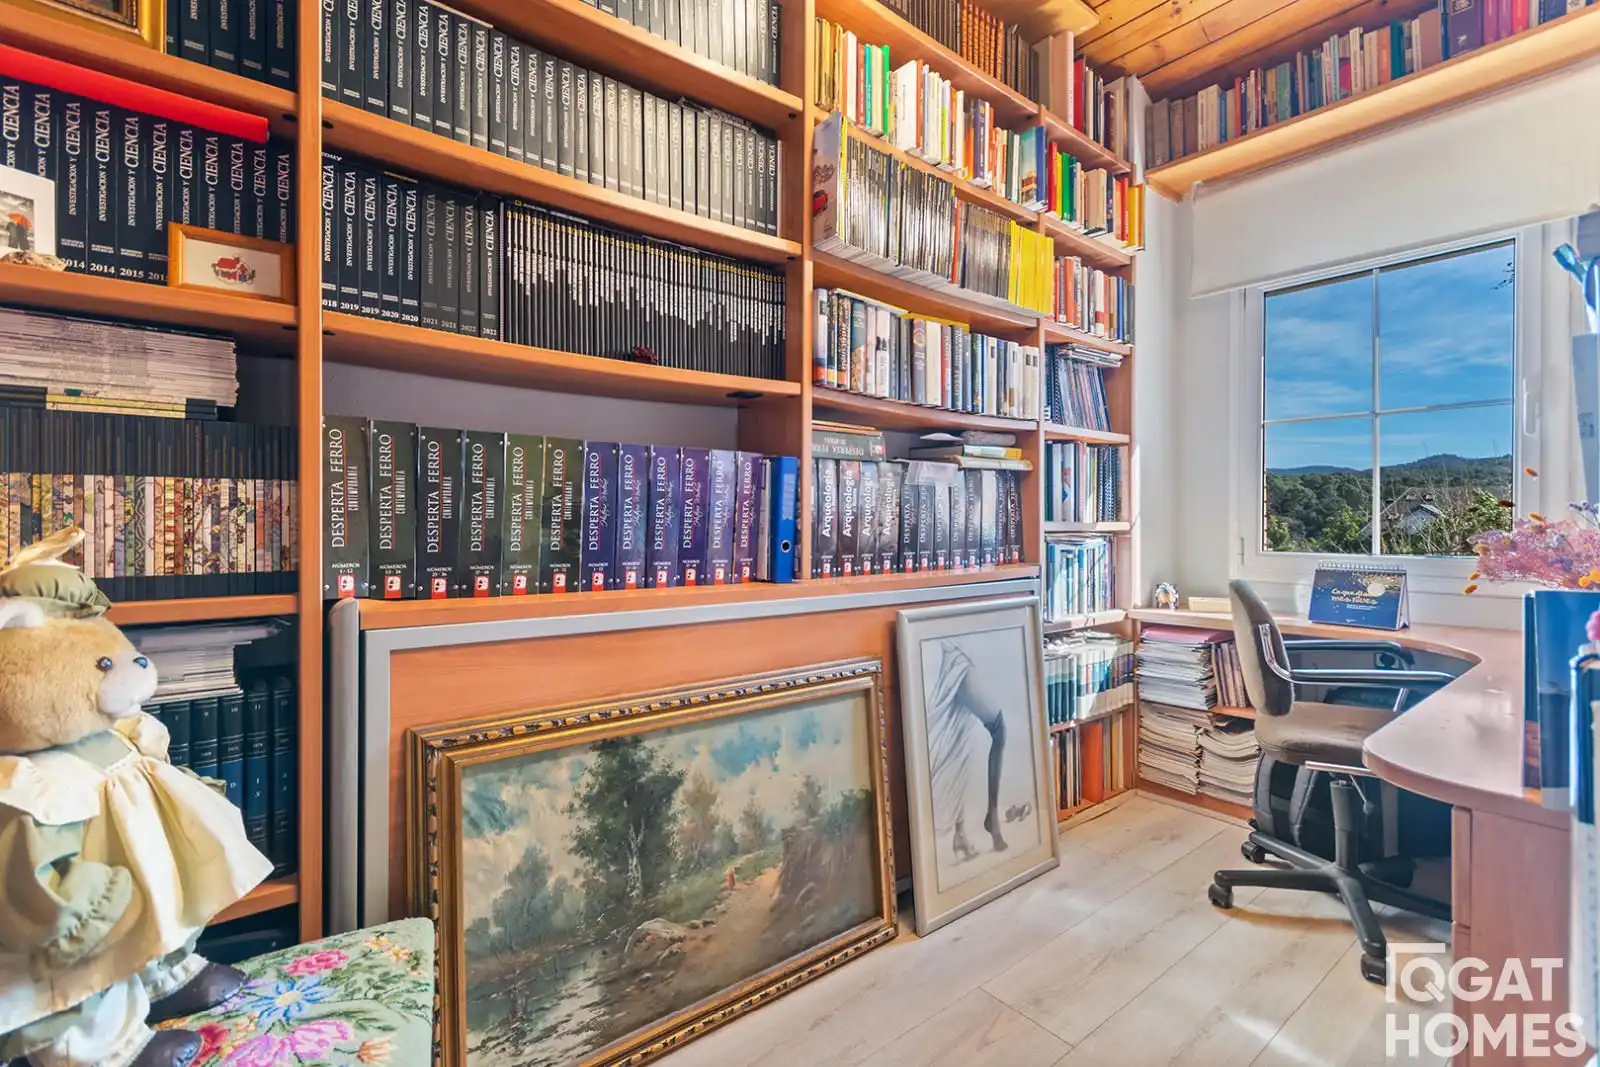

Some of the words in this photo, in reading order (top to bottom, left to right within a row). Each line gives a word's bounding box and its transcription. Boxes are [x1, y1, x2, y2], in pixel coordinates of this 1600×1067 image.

[419, 6, 429, 49] CIENCIA
[439, 14, 449, 56] CIENCIA
[458, 23, 468, 65] CIENCIA
[476, 30, 486, 72] CIENCIA
[494, 36, 504, 78] CIENCIA
[511, 46, 520, 86] CIENCIA
[529, 53, 538, 93] CIENCIA
[546, 61, 555, 99] CIENCIA
[562, 67, 571, 106] CIENCIA
[578, 74, 587, 112] CIENCIA
[3, 85, 21, 141] CIENCIA
[35, 93, 51, 148] CIENCIA
[66, 102, 81, 155] CIENCIA
[96, 110, 111, 162] CIENCIA
[125, 117, 140, 168] CIENCIA
[153, 123, 168, 173] CIENCIA
[180, 129, 194, 179] CIENCIA
[205, 136, 219, 185] CIENCIA
[231, 143, 244, 191] CIENCIA
[254, 149, 267, 197] CIENCIA
[277, 154, 291, 201] CIENCIA
[768, 144, 777, 177] CIENCIA
[69, 163, 78, 216] INVESTIGACION
[99, 170, 108, 222] INVESTIGACION
[128, 176, 137, 227] INVESTIGACION
[156, 182, 164, 232] INVESTIGACION
[323, 164, 335, 210] CIENCIA
[345, 171, 357, 216] CIENCIA
[365, 177, 377, 222] CIENCIA
[386, 183, 398, 227] CIENCIA
[406, 190, 418, 233] CIENCIA
[427, 194, 437, 237] CIENCIA
[446, 199, 456, 242] CIENCIA
[465, 204, 475, 246] CIENCIA
[486, 209, 495, 250] CIENCIA
[90, 262, 116, 274] 2014
[119, 267, 145, 279] 2015
[147, 271, 168, 281] 201
[322, 298, 338, 308] 018
[340, 302, 360, 311] 2019
[361, 306, 380, 315] 2019
[381, 309, 400, 318] 2020
[401, 313, 419, 322] 2020
[328, 428, 344, 473] FERRO
[379, 433, 393, 477] FERRO
[427, 441, 441, 483] FERRO
[472, 443, 485, 484] FERRO
[512, 446, 525, 486] FERRO
[552, 448, 565, 487] FERRO
[589, 452, 600, 489] FERRO
[623, 454, 634, 490] FERRO
[656, 456, 667, 492] FERRO
[684, 458, 696, 492] FERRO
[715, 460, 726, 493] FERRO
[743, 462, 753, 494] FERRO
[331, 480, 346, 548] DESPERTA
[379, 485, 393, 550] DESPERTA
[427, 491, 440, 553] DESPERTA
[471, 491, 484, 552] DESPERTA
[510, 493, 523, 551] DESPERTA
[550, 494, 563, 550] DESPERTA
[589, 496, 600, 551] DESPERTA
[623, 497, 634, 550] DESPERTA
[654, 498, 666, 550] DESPERTA
[683, 498, 694, 549] DESPERTA
[713, 500, 723, 549] DESPERTA
[740, 500, 751, 548] DESPERTA
